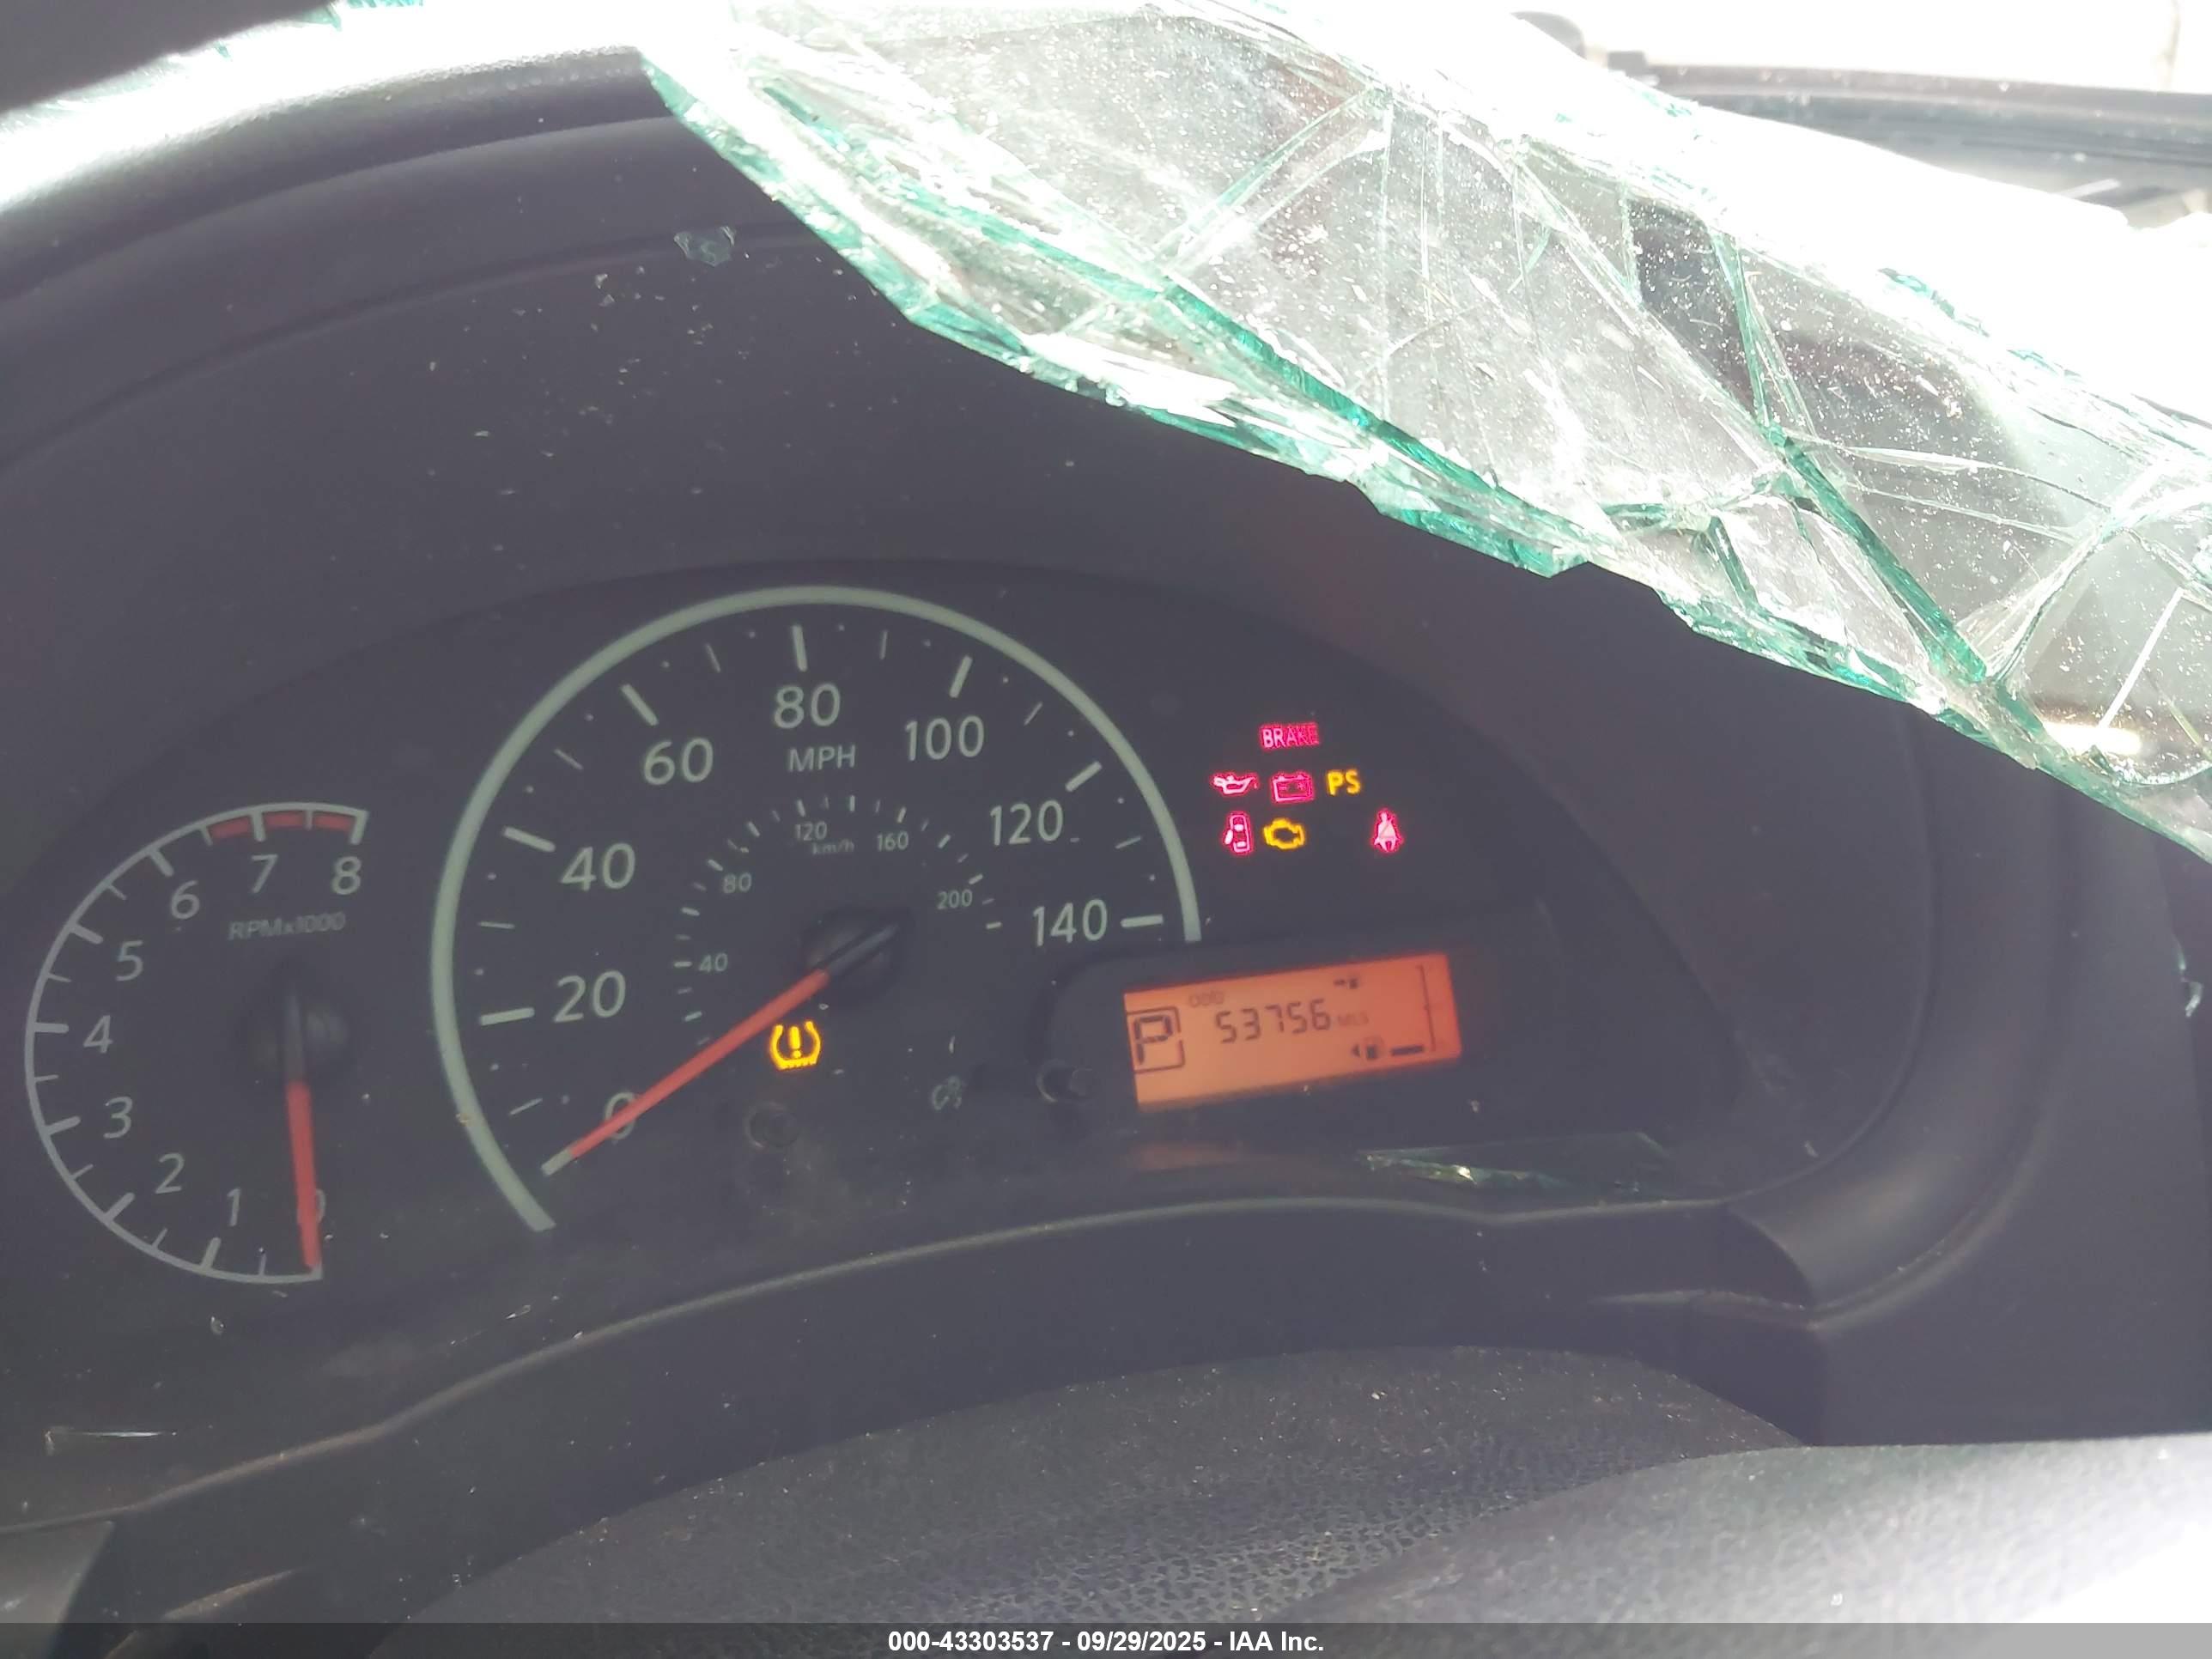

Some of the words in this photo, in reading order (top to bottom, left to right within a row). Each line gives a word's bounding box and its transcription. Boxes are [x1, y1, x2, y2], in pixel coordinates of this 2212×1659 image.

[774, 684, 841, 728] 80
[904, 715, 984, 761] 100
[1260, 723, 1319, 750] BRAKE
[642, 738, 714, 785] 60
[787, 744, 855, 772] MPH
[1327, 769, 1360, 795] PS
[794, 821, 827, 842] 120
[877, 831, 908, 851] 160
[989, 799, 1064, 846] 120
[560, 842, 635, 891] 40
[811, 840, 854, 855] km/h
[252, 854, 277, 894] 7
[331, 856, 362, 895] 8
[722, 872, 752, 894] 80
[171, 881, 200, 919] 6
[937, 889, 973, 910] 200
[1032, 899, 1108, 946] 140
[116, 941, 143, 981] 5
[697, 952, 728, 973] 40
[553, 970, 626, 1023] 20
[82, 1015, 113, 1054] 4
[1133, 1014, 1173, 1065] P
[1215, 998, 1331, 1044] 53756
[102, 1097, 133, 1139] 3
[605, 1091, 638, 1141] 0
[155, 1152, 185, 1194] 2
[227, 1188, 241, 1226] 1
